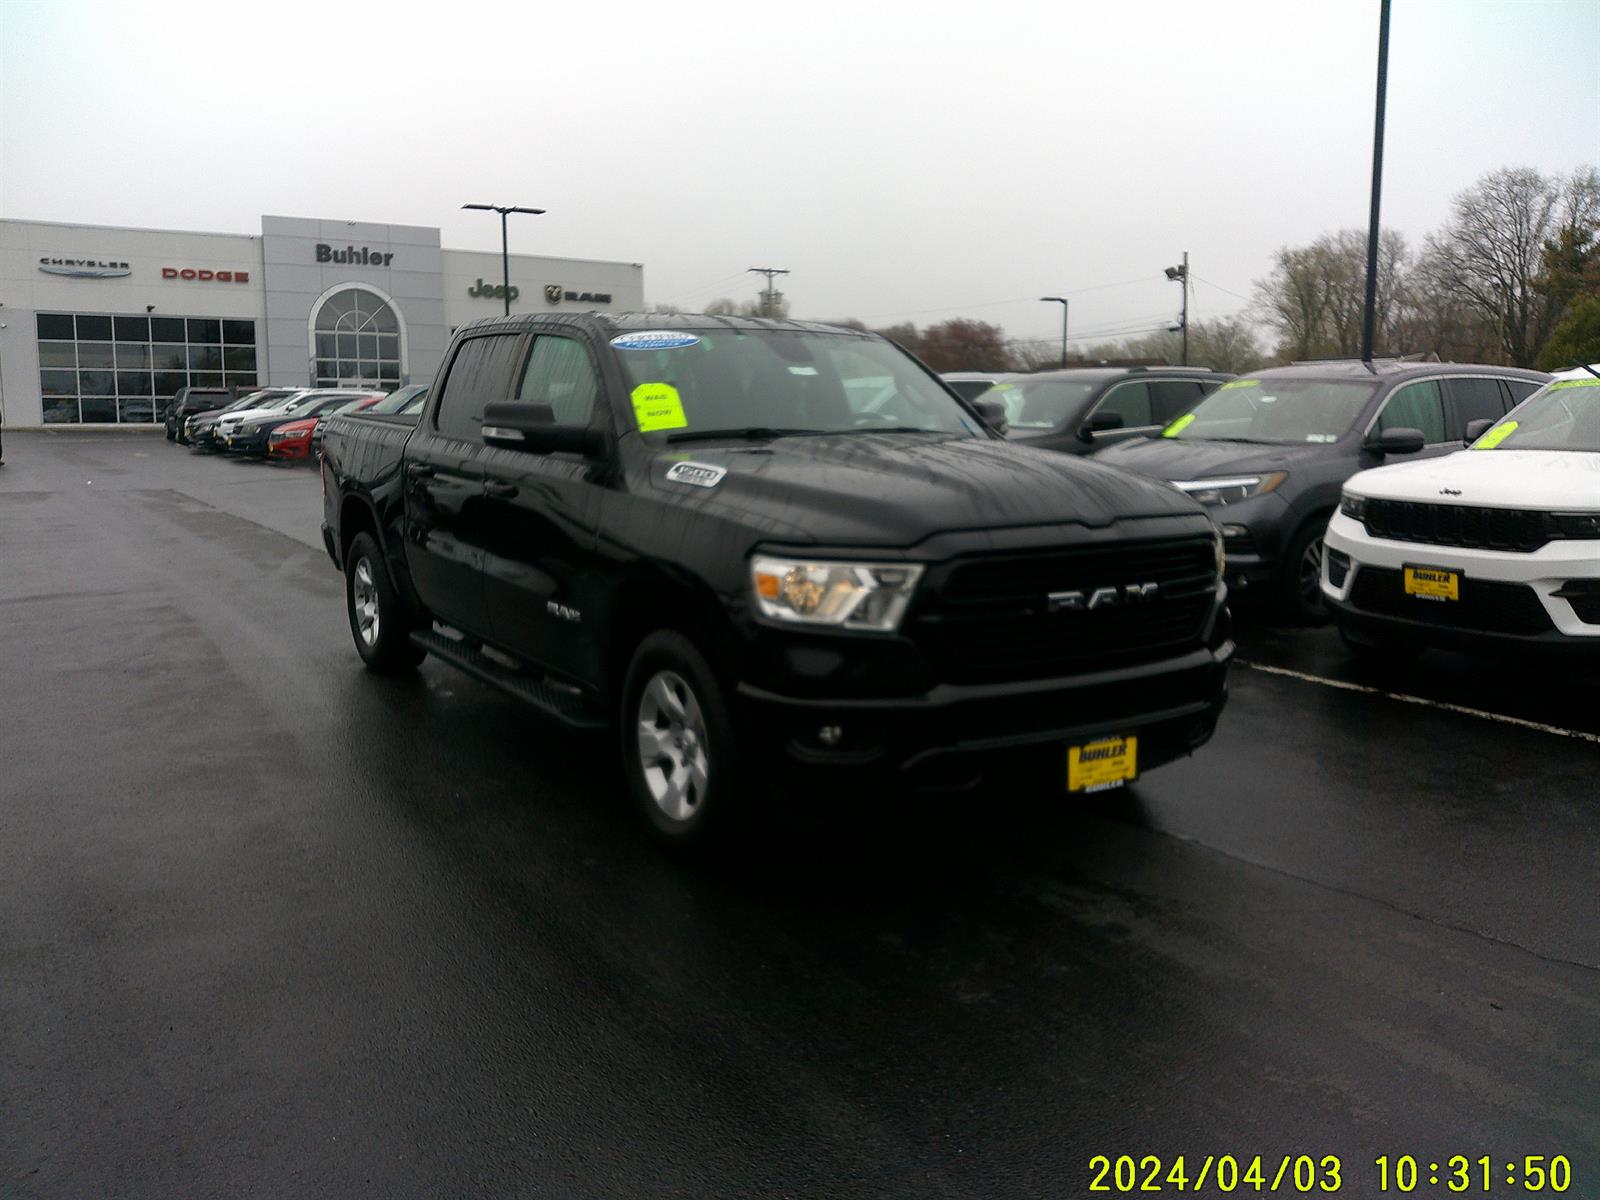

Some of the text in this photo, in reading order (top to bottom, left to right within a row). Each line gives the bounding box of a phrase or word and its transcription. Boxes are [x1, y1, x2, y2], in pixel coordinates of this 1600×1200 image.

[39, 257, 130, 270] CHRYSLER
[315, 243, 394, 268] Buhler
[161, 267, 249, 284] DODGE
[469, 278, 520, 301] Jeep
[564, 291, 612, 304] RAM
[1047, 581, 1160, 612] RAM
